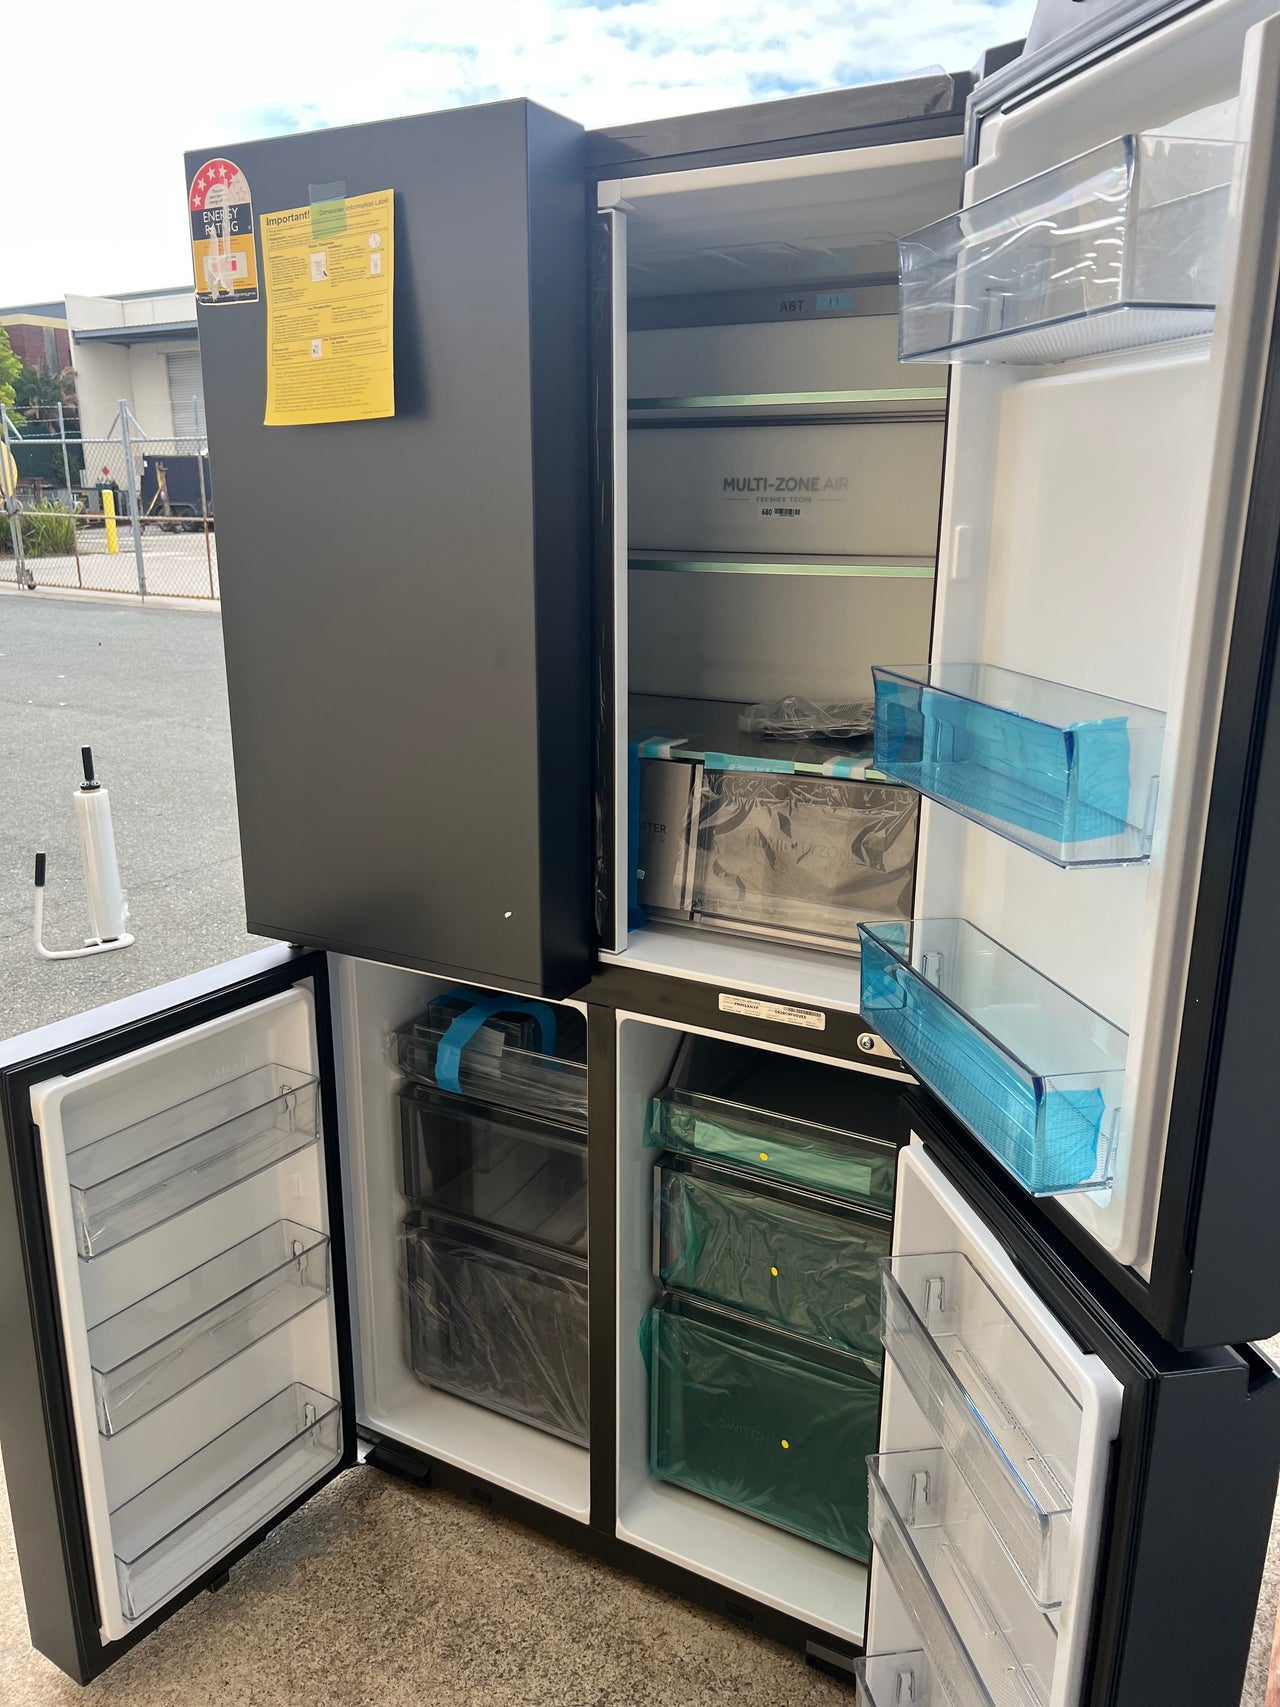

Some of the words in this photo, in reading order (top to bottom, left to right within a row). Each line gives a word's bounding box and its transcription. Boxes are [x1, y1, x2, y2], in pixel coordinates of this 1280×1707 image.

[319, 204, 344, 216] Consumer
[346, 198, 374, 211] Information
[375, 196, 390, 205] Label
[266, 210, 310, 226] Important!
[723, 477, 820, 492] MULTI-ZONE
[822, 476, 849, 492] AIR
[639, 822, 667, 834] ATER
